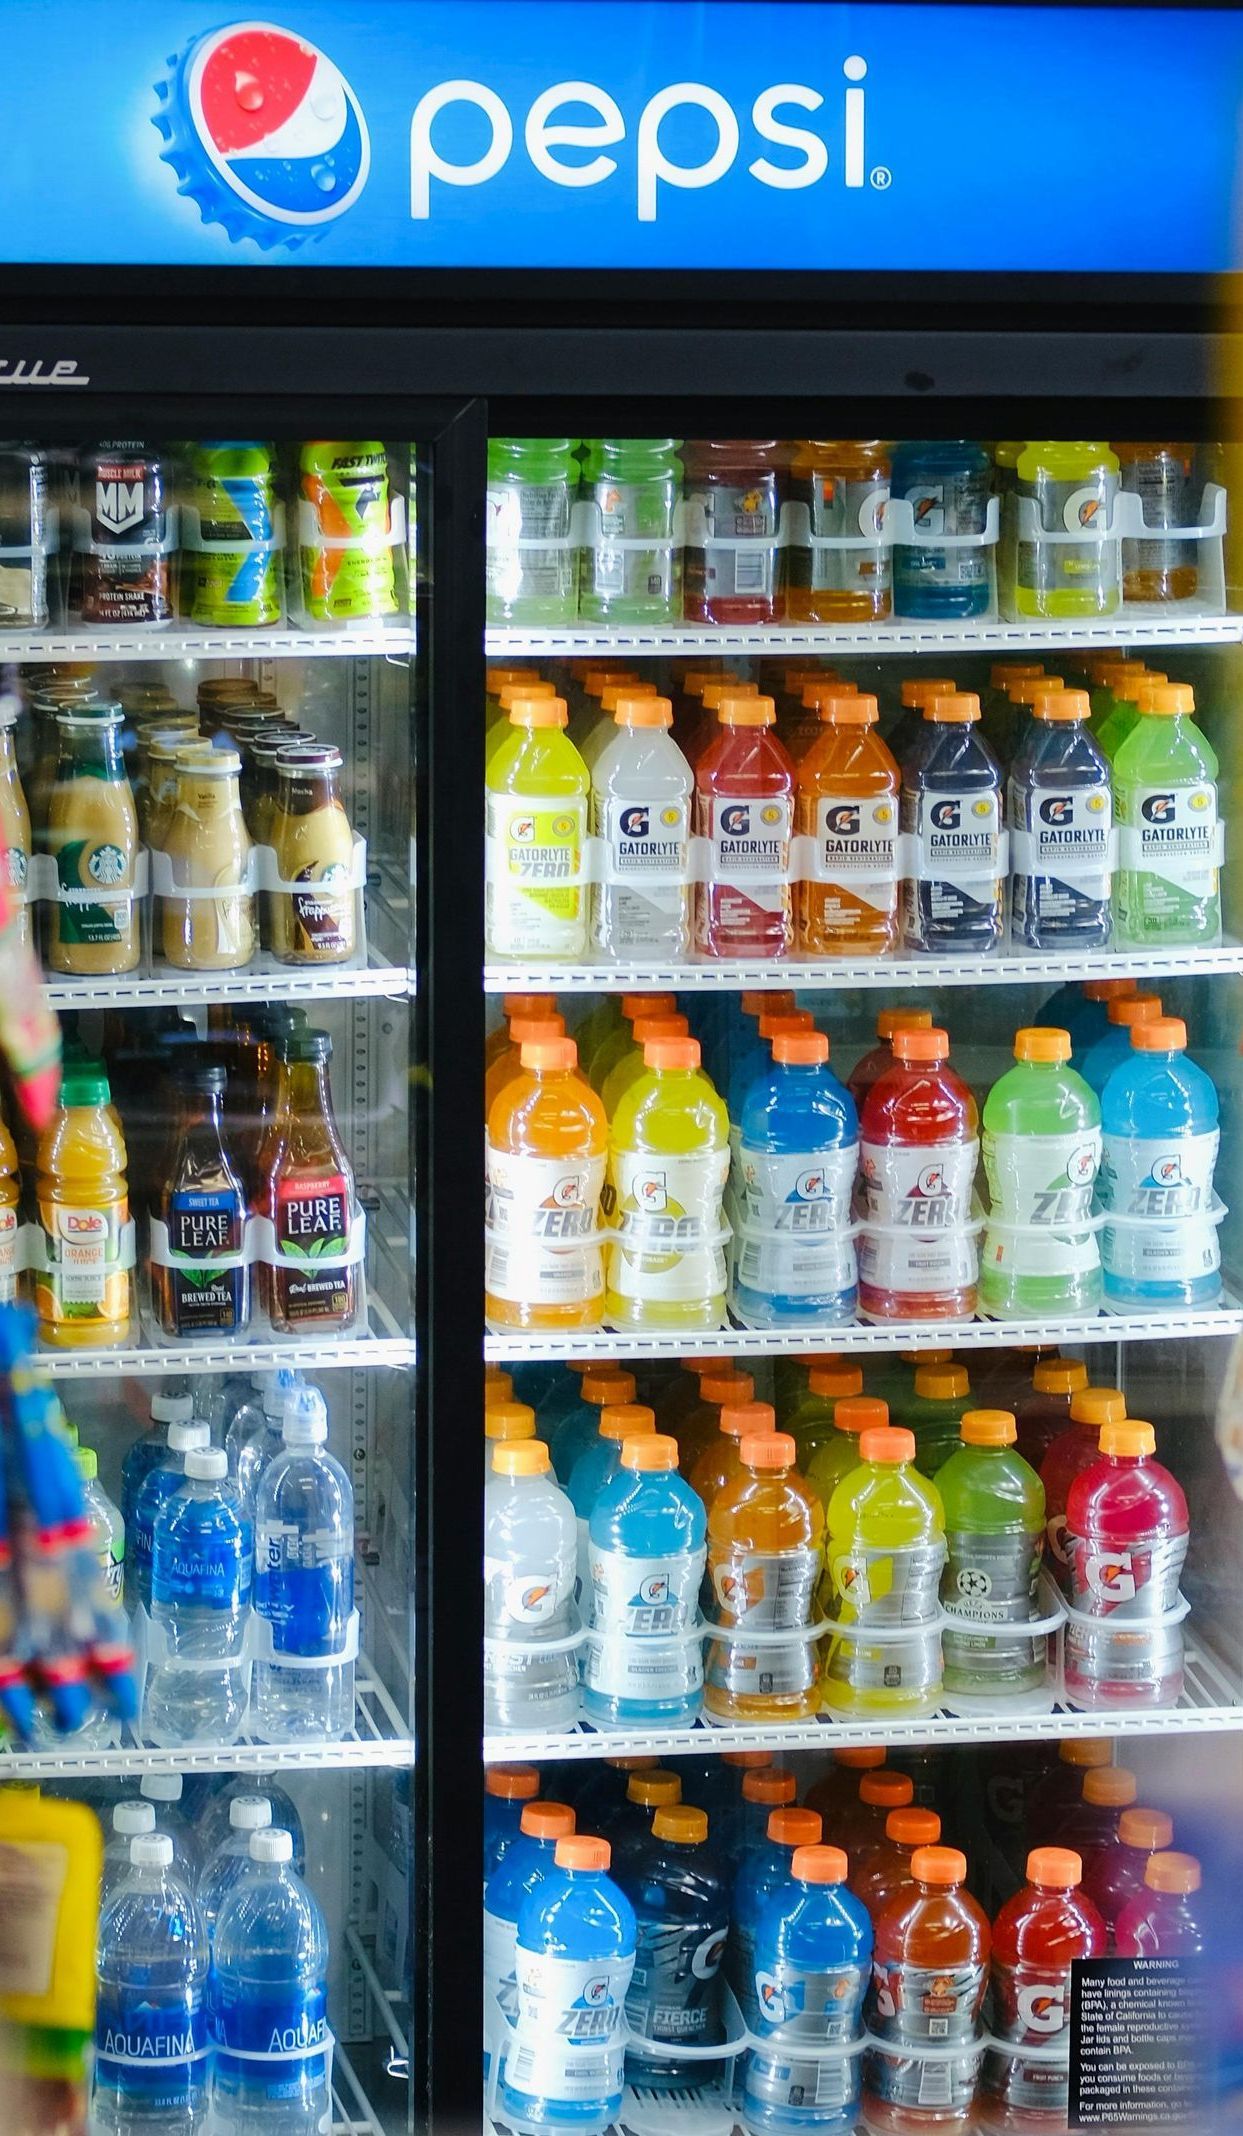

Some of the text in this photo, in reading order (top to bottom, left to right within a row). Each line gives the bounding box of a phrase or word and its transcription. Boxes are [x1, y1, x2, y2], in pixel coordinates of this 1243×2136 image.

[411, 55, 866, 222] pepsi
[332, 456, 363, 469] FAST
[123, 470, 141, 479] MILK
[930, 800, 961, 830] G
[1039, 796, 1074, 827] G
[1141, 794, 1176, 824] G
[619, 807, 650, 838] G
[720, 805, 750, 836] G
[825, 805, 860, 836] G
[930, 834, 991, 847] GATORLYTE
[1040, 829, 1105, 844] GATORLYTE
[1142, 826, 1209, 842] GATORLYTE
[619, 841, 679, 855] GATORLYTE
[720, 840, 780, 854] GATORLYTE
[825, 839, 894, 853] GATORLYTE
[510, 847, 570, 861] GATORLYTE
[294, 1181, 330, 1191] RASPBERRY
[188, 1197, 220, 1207] SWEET TEA
[287, 1198, 341, 1217] PURE
[1128, 1187, 1200, 1216] ZERO
[67, 1215, 102, 1231] Dole
[180, 1215, 228, 1231] PURE
[533, 1208, 593, 1237] ZERO
[64, 1248, 103, 1257] ORANGE
[307, 1282, 333, 1292] BREWED
[333, 1280, 346, 1290] TEA
[182, 1291, 232, 1303] BREWED TEA
[171, 1562, 225, 1576] AQUAFINA
[1085, 1552, 1136, 1602] G
[945, 1605, 1004, 1619] CHAMPIONS
[1133, 1960, 1180, 1970] WARNING
[1081, 1977, 1105, 1988] Many
[1107, 1977, 1127, 1986] food
[1128, 1976, 1144, 1986] and
[1081, 1989, 1102, 1999] have
[1104, 1989, 1131, 2000] linings
[1133, 1988, 1177, 1999] containing
[1016, 1984, 1065, 2033] G
[1081, 1999, 1186, 2011] (BPA), a chemical known
[555, 2006, 620, 2036] ZERO
[653, 2007, 708, 2026] FIERCE
[1081, 2012, 1103, 2022] State
[1105, 2012, 1114, 2021] of
[1115, 2011, 1156, 2020] California
[1158, 2010, 1167, 2019] to
[1080, 2023, 1094, 2033] the
[1096, 2023, 1125, 2033] female
[1127, 2022, 1179, 2033] reproductive
[104, 2028, 196, 2057] AQUAFINA
[1080, 2036, 1094, 2045] Jar
[1096, 2035, 1111, 2044] lids
[1113, 2034, 1129, 2043] and
[1131, 2033, 1154, 2043] bottle
[1156, 2034, 1176, 2043] caps
[1080, 2046, 1134, 2056] contain BPA.
[1080, 2062, 1096, 2072] You
[1098, 2063, 1114, 2072] can
[1116, 2062, 1127, 2071] be
[1129, 2061, 1165, 2072] exposed
[1167, 2061, 1176, 2069] to
[1080, 2075, 1096, 2086] you
[1097, 2075, 1136, 2084] consume
[1138, 2073, 1161, 2082] foods
[1079, 2086, 1121, 2096] packaged
[1123, 2085, 1131, 2094] in
[1132, 2084, 1156, 2094] these
[1079, 2102, 1094, 2111] For
[1096, 2103, 1118, 2111] more
[1119, 2099, 1168, 2110] information,
